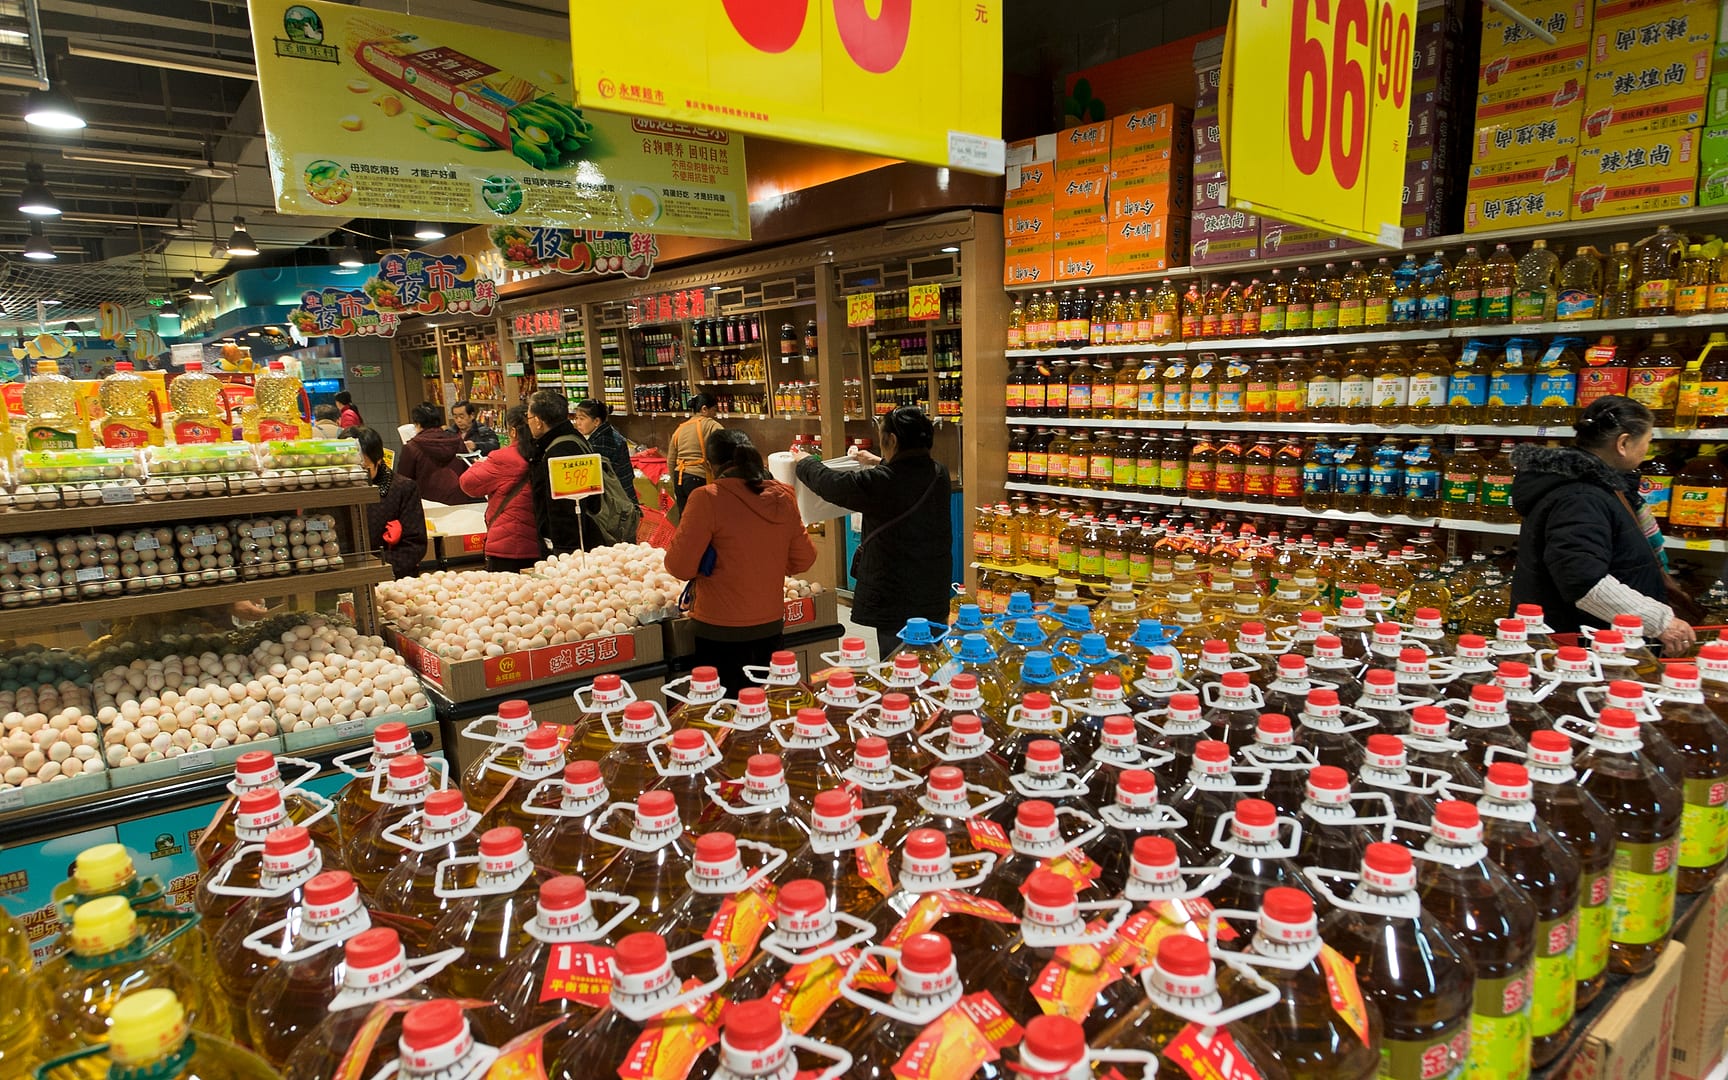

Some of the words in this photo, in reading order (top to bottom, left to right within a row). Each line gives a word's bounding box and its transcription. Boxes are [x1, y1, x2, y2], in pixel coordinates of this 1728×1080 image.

[975, 4, 988, 24] 元
[1615, 17, 1688, 51] 辣煌尚
[1612, 63, 1687, 96] 辣煌尚
[619, 83, 665, 102] 永辉超市
[642, 138, 684, 155] 谷物喂养
[689, 143, 729, 164] 回归自然
[1599, 144, 1672, 174] 辣煌尚
[350, 163, 400, 176] 母鸡吃得好
[411, 168, 457, 180] 才能产好蛋
[1204, 212, 1246, 232] 辣煌尚
[548, 914, 580, 927] 金龙鱼
[789, 919, 820, 930] 金龙鱼
[921, 977, 953, 992] 金龙鱼
[751, 1048, 785, 1069] 金龙鱼
